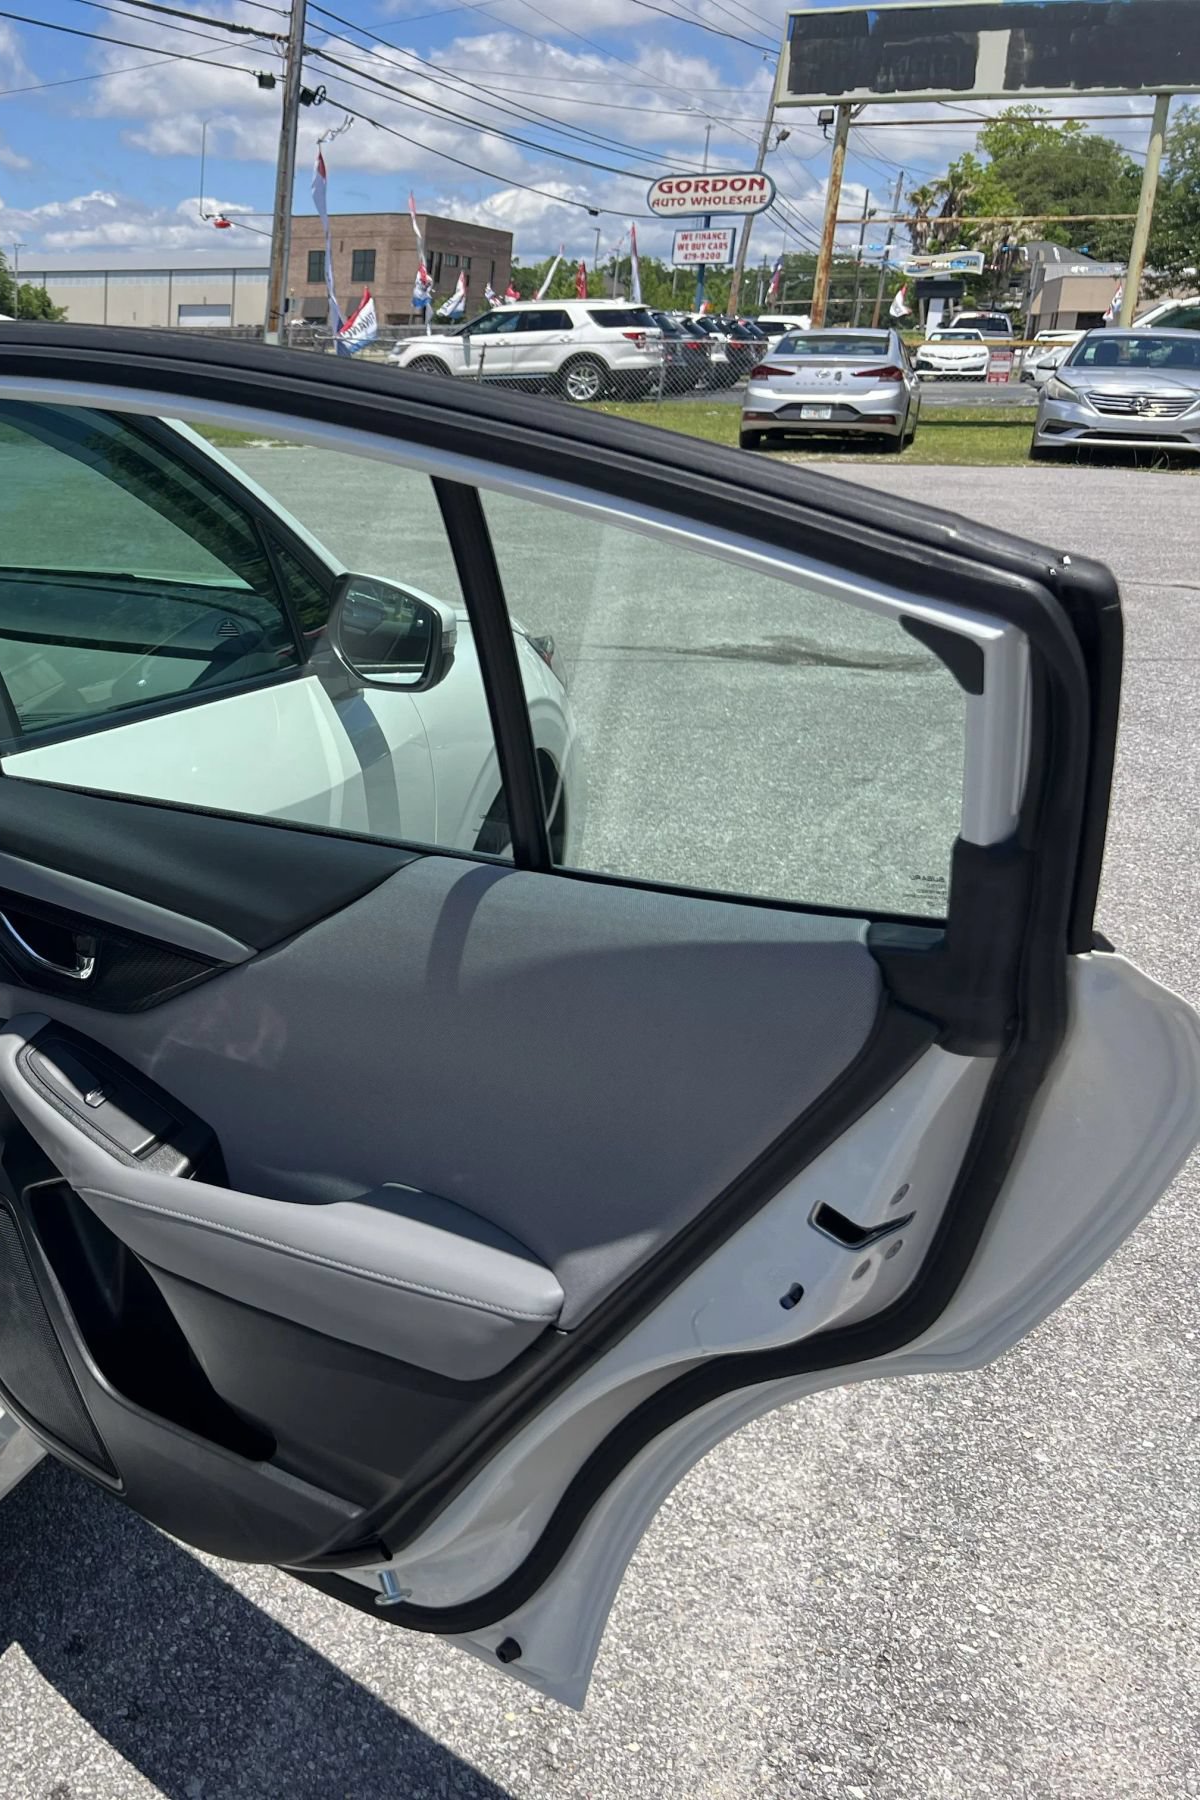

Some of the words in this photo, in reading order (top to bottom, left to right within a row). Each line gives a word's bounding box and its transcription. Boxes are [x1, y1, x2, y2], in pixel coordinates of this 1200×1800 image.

[658, 178, 765, 194] GORDON
[652, 198, 686, 207] AUTO
[691, 195, 767, 206] WHOLESALE
[681, 233, 693, 241] WE
[695, 232, 728, 241] FINANCE
[677, 243, 689, 251] WE
[691, 243, 706, 251] BUY
[708, 242, 728, 250] CARS
